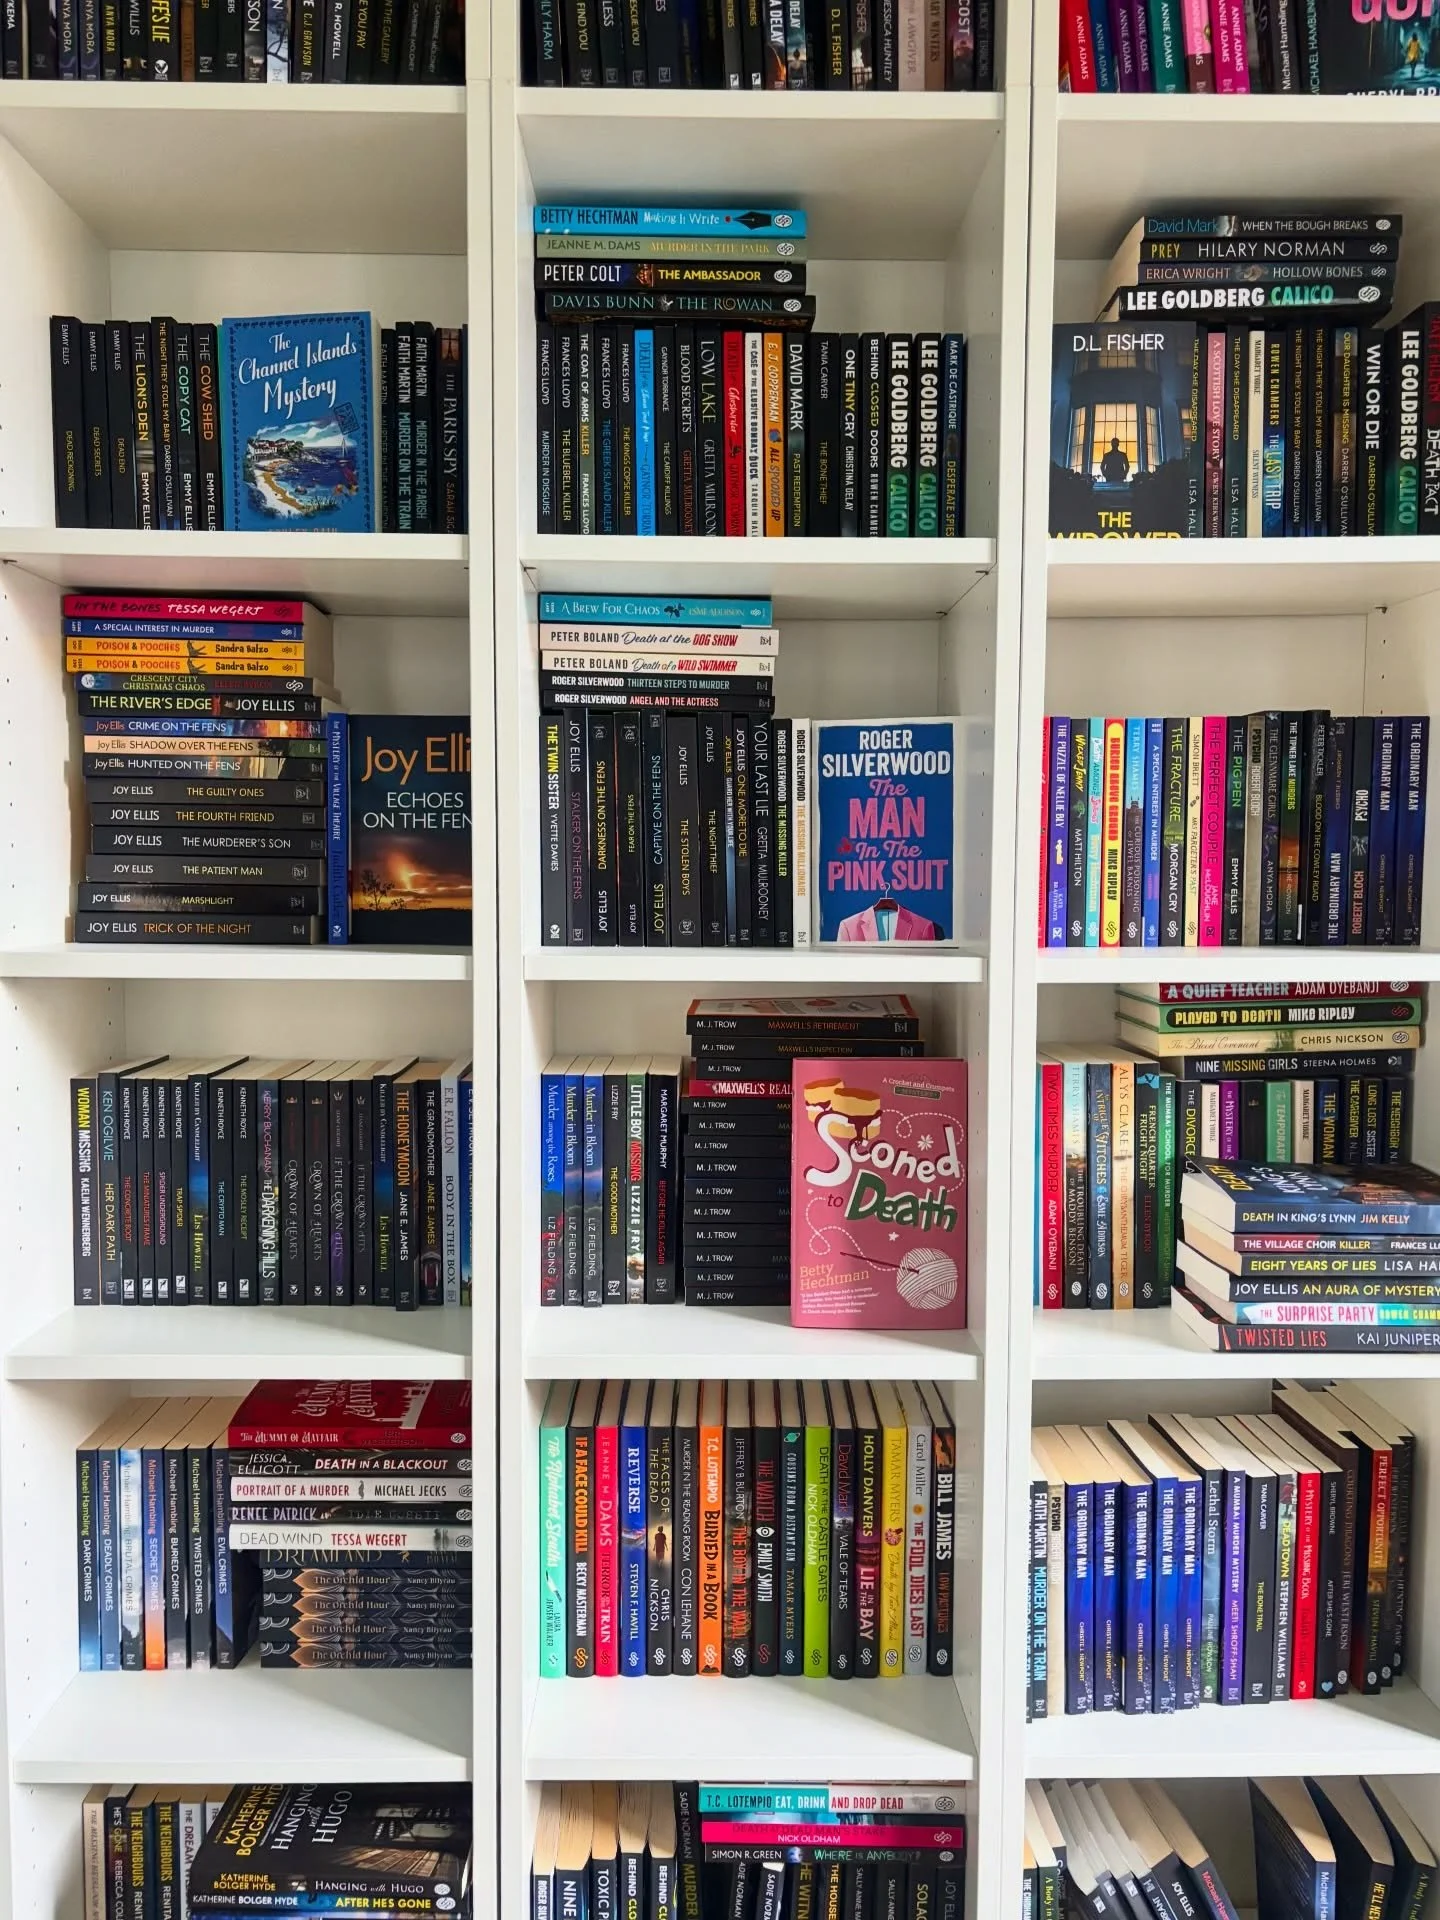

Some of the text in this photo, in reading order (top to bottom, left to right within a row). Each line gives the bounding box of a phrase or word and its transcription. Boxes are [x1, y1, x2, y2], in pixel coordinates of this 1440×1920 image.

[577, 3, 588, 50] FIND YOU
[1076, 16, 1089, 79] ANNIE ADAMS
[541, 209, 638, 225] BETTY HECHTMAN
[1148, 219, 1368, 233] David Mark WHEN THE BOUGH BREAKS
[1151, 242, 1345, 258] PREY HILARY NORMAN
[544, 265, 761, 282] PETER COLT THE AMBASSADOR
[553, 295, 772, 311] DAVIS BUNN THE ROWAN
[1127, 285, 1334, 311] LEE GOLDBERG CALICO
[269, 332, 291, 353] The
[1073, 334, 1164, 352] D.L. FISHER
[239, 332, 357, 385] Channel Islands
[134, 333, 148, 440] THE LION'S DEN
[199, 334, 213, 440] THE COW SHED
[263, 377, 337, 419] Mystery
[790, 344, 802, 430] DAVID MARK
[845, 349, 855, 439] ONE TINY CRY
[1366, 344, 1380, 449] WIN OR DIE
[890, 341, 908, 531] LEE GOLDBERG CALICO
[1098, 512, 1131, 528] THE
[167, 604, 263, 616] TESSA WEGERT
[551, 631, 738, 646] PETER BOLAND Death DOG SHOW
[90, 696, 295, 711] THE RIVER'S EDGE JOY ELLIS
[859, 730, 912, 750] ROGER
[361, 736, 418, 785] Joy
[547, 724, 559, 809] THE TWIN SISTER
[822, 751, 950, 777] SILVERWOOD
[869, 777, 909, 796] The
[387, 792, 464, 808] ECHOES
[363, 812, 437, 829] ON THE
[850, 797, 925, 839] MAN
[1169, 725, 1182, 912] THE FRACTURE MORGAN CRY
[856, 840, 922, 860] In The
[828, 859, 948, 891] PINK SUIT
[1301, 1034, 1383, 1044] CHRIS NICKSON
[631, 1085, 642, 1139] LITTLE BOY
[78, 1087, 91, 1172] WOMAN MISSING
[805, 1111, 961, 1187] Sconed
[827, 1193, 844, 1207] to
[844, 1169, 958, 1233] Death
[105, 1184, 116, 1260] HER DARK PATH
[1243, 1213, 1410, 1224] DEATH IN KING'S LYNN JIM KELLY
[799, 1264, 834, 1278] Betty
[799, 1269, 870, 1290] Hechtman
[1235, 1284, 1380, 1295] JOY ELLIS AN AURA OF
[1236, 1329, 1379, 1346] TWISTED LIES KAI
[315, 1458, 448, 1470] DEATH IN A BLACKOUT
[237, 1484, 447, 1497] PORTRAIT OF A MURDER MICHAEL JECKS
[628, 1447, 640, 1513] REVERSE
[936, 1473, 952, 1560] BILL JAMES
[331, 1534, 407, 1546] TESSA WEGERT
[1077, 1489, 1087, 1578] THE ORDINARY MAN
[704, 1510, 720, 1620] BURIED BOOK
[84, 1566, 92, 1601] CRIMES
[859, 1567, 874, 1640] LIE BAY
[1276, 1580, 1290, 1678] STEPHEN WILLIAMS
[775, 1795, 903, 1809] EAT, DRINK AND DROP DEAD
[778, 1834, 840, 1843] NICK OLDHAM
[564, 1881, 576, 1916] NINE
[598, 1869, 609, 1908] TOXIC
[193, 1895, 431, 1909] KATHERINE BOLGER HYDE AFTER GONE
